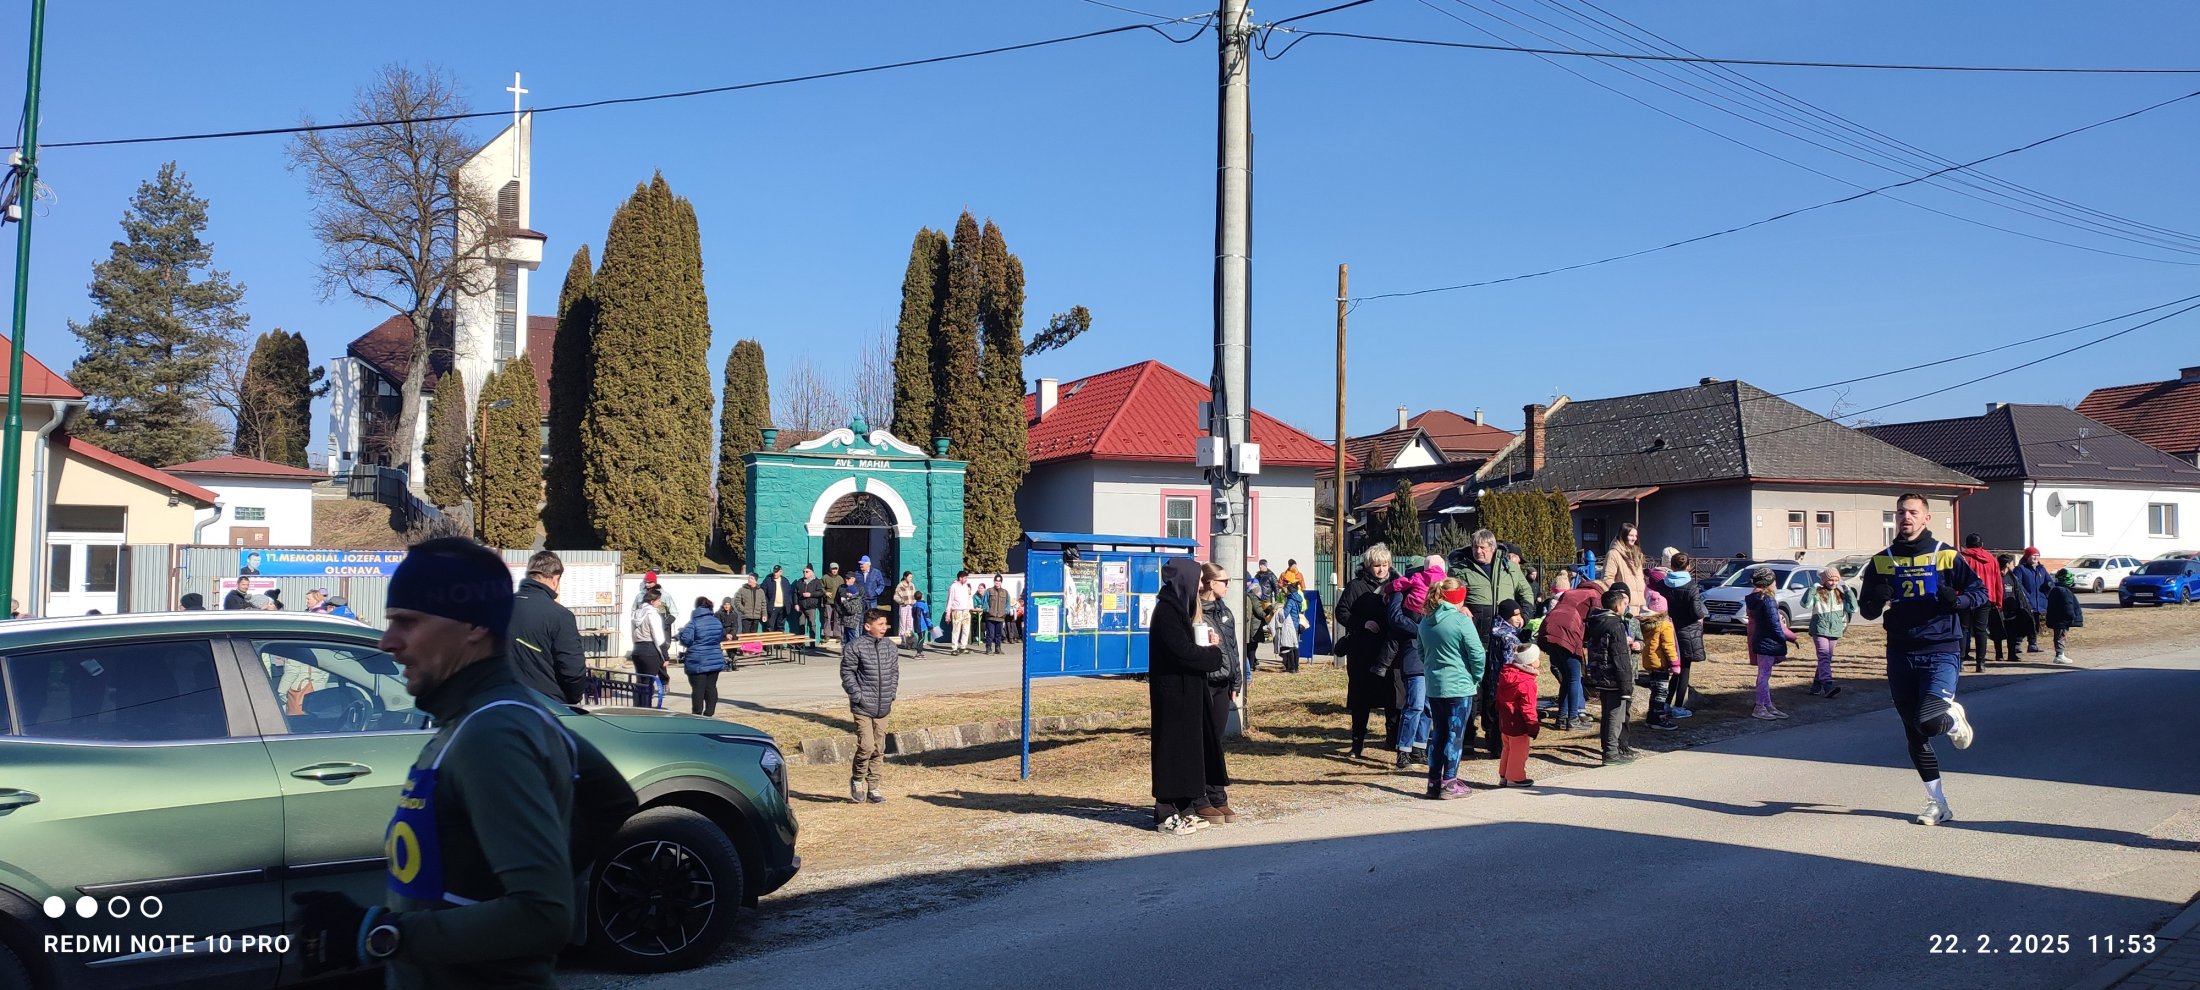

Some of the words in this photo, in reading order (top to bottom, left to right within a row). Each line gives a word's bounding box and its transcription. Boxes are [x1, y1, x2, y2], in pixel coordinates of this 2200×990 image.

[834, 459, 854, 467] AVE
[859, 460, 890, 468] MARIA
[342, 553, 382, 563] JOZEFA
[384, 553, 402, 563] KRI
[324, 566, 382, 575] OLCNAVA
[1902, 580, 1925, 597] 21
